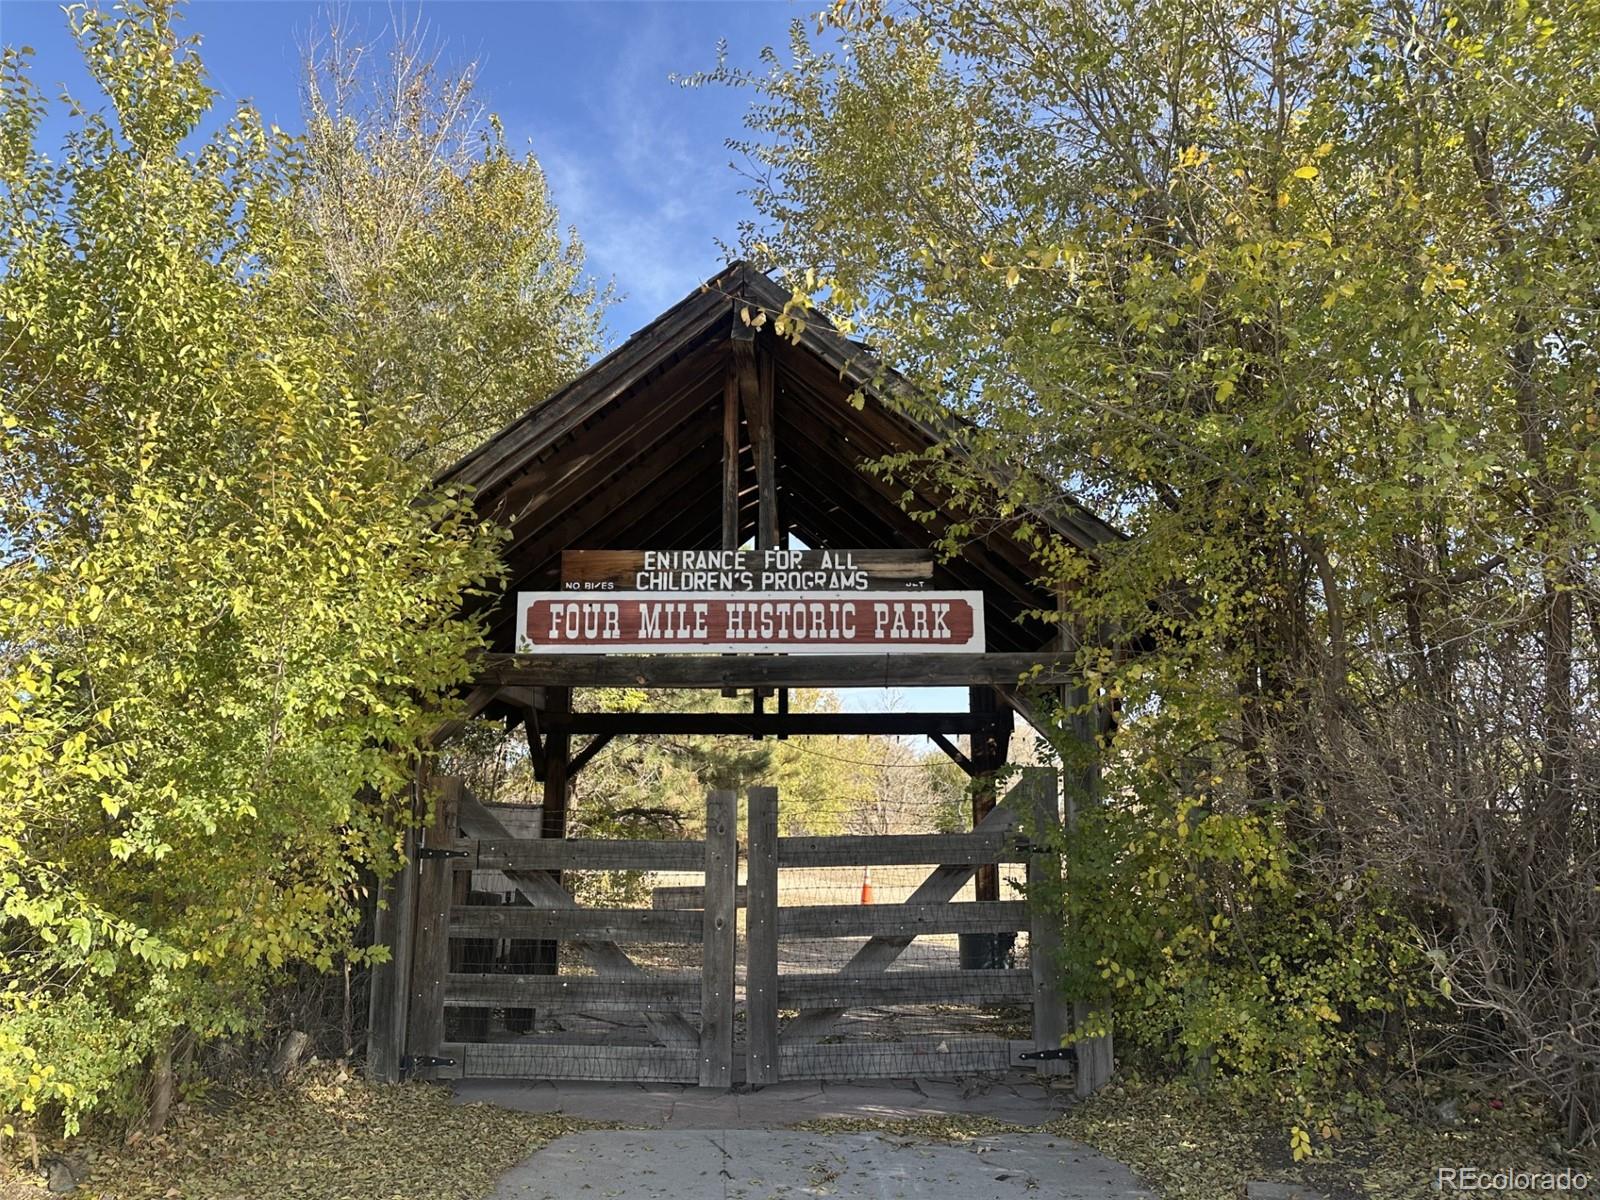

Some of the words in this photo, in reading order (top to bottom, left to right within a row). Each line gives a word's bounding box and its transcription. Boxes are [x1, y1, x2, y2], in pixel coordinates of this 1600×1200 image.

[644, 551, 746, 570] ENTRANCE
[764, 550, 803, 570] FOR
[821, 550, 858, 570] ALL
[565, 582, 580, 590] NO
[636, 571, 754, 591] CHILDREN'S
[761, 571, 869, 591] PROGRAMS
[548, 603, 621, 639] FOUR
[638, 603, 708, 639] MILE
[725, 602, 856, 639] HISTORIC
[873, 603, 951, 639] PARK
